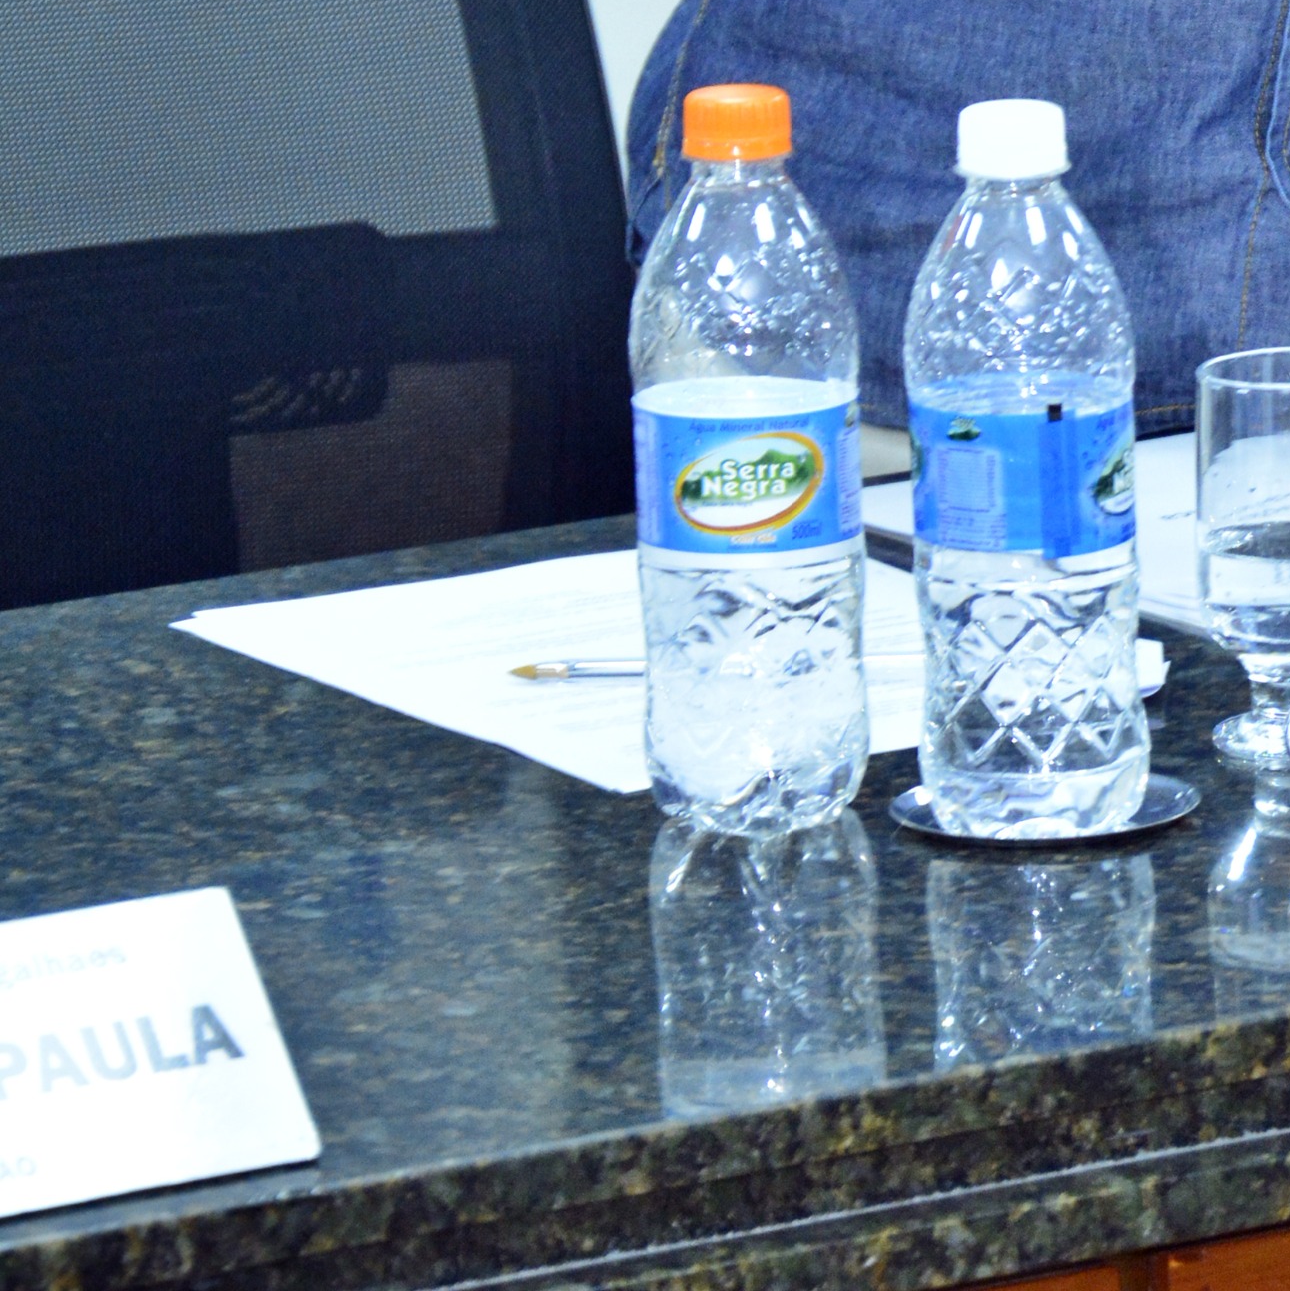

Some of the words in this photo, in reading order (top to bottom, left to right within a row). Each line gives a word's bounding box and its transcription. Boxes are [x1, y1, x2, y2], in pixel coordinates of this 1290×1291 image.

[720, 460, 796, 480] Serra
[702, 475, 787, 500] Negra
[0, 1002, 247, 1101] PAULA
